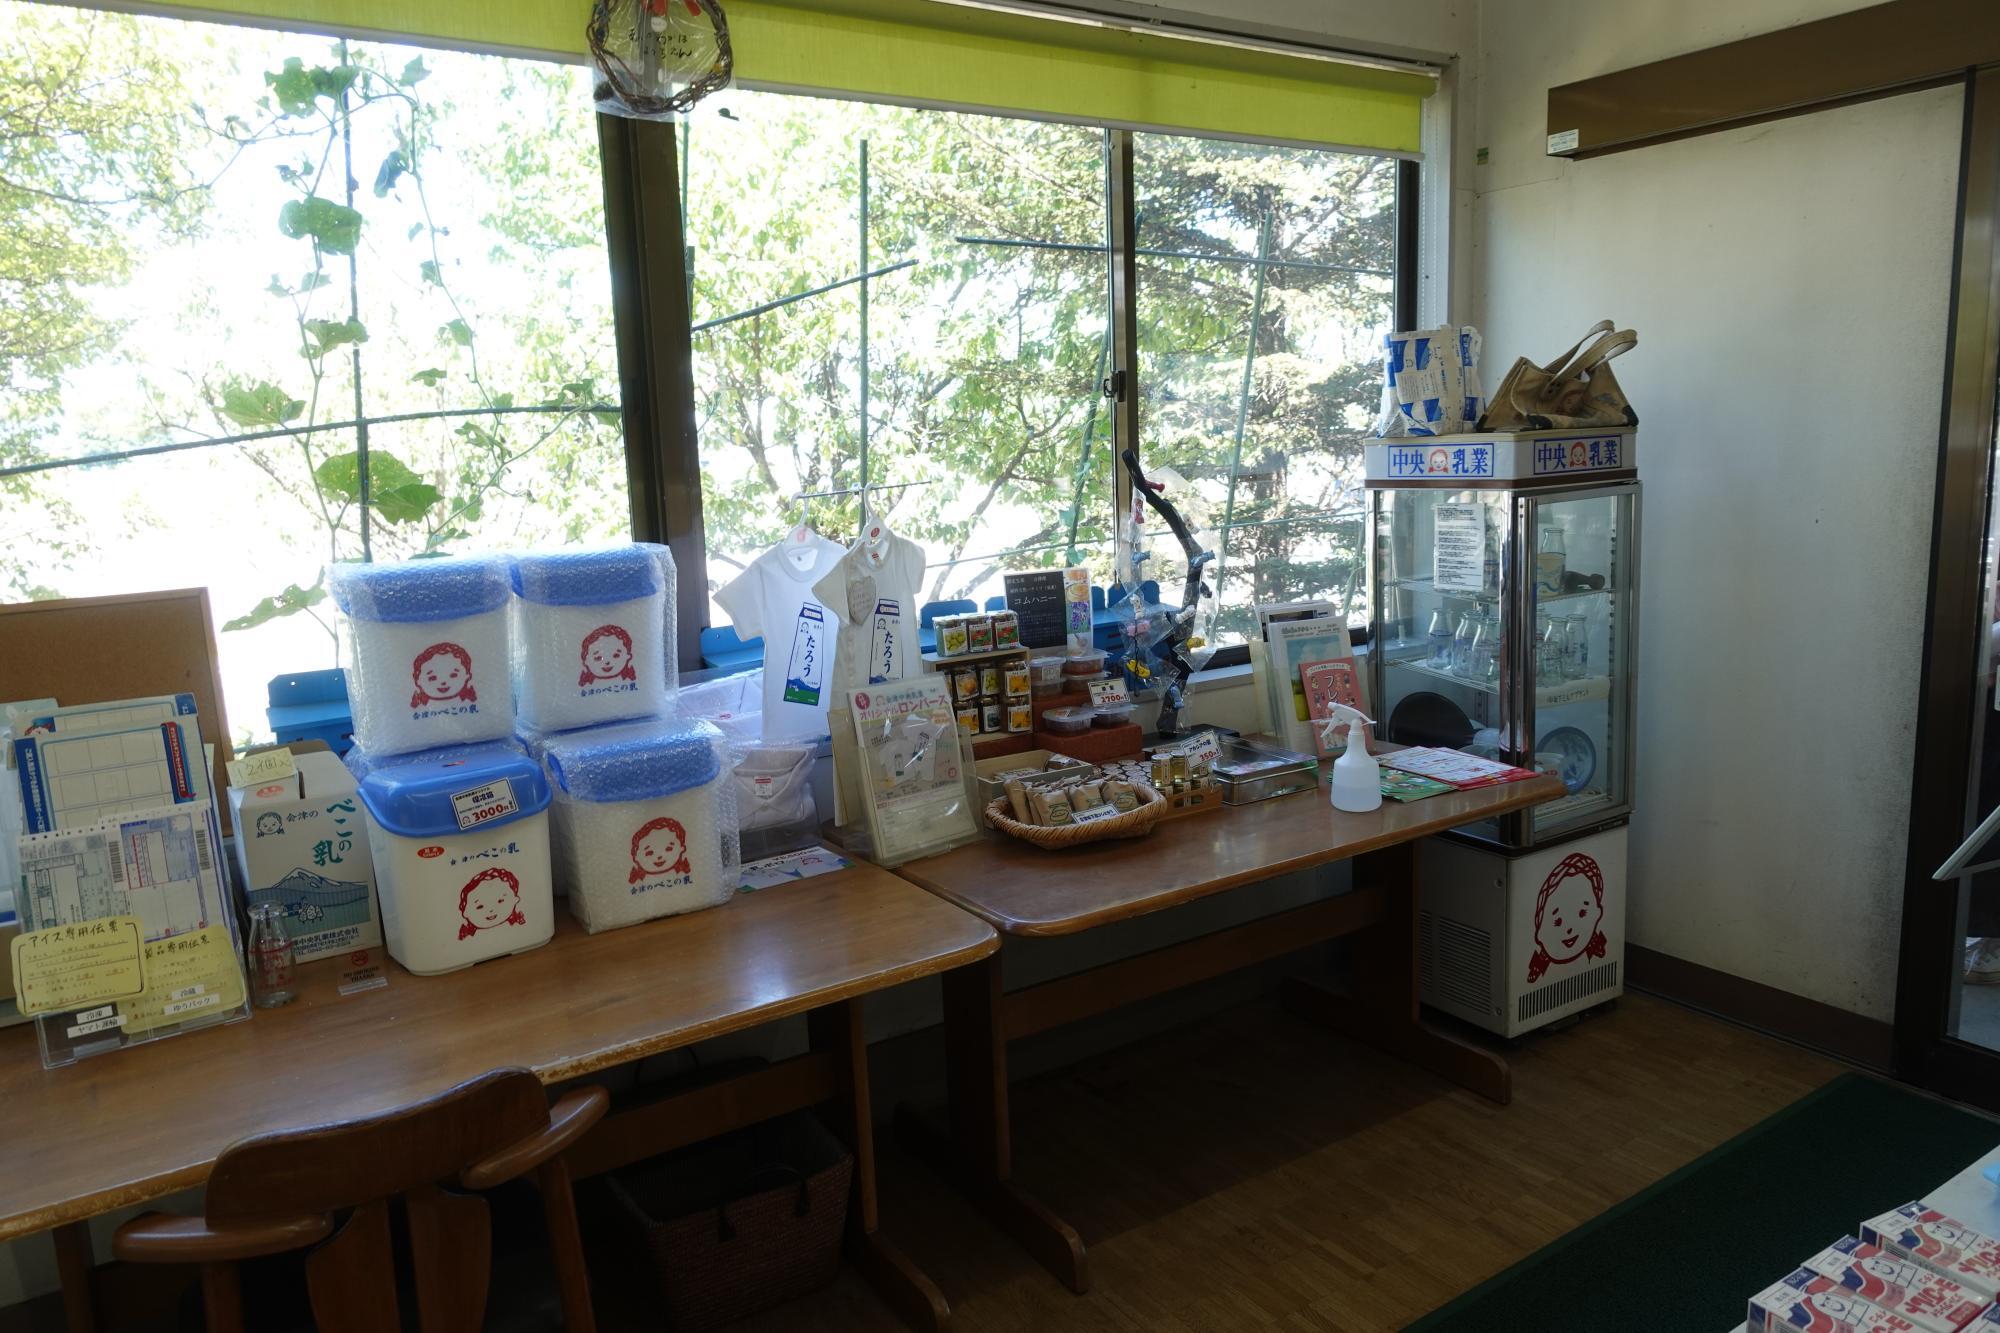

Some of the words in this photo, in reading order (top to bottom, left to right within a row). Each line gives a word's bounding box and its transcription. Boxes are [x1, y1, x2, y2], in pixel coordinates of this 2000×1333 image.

[1392, 448, 1425, 475] 中央
[1451, 447, 1489, 475] 乳業
[1537, 442, 1568, 471] 中央
[1588, 438, 1619, 466] 乳業
[803, 633, 816, 678] たろう
[883, 630, 893, 675] たろう
[286, 809, 319, 823] 会津の
[29, 919, 120, 946] アイス専用伝票
